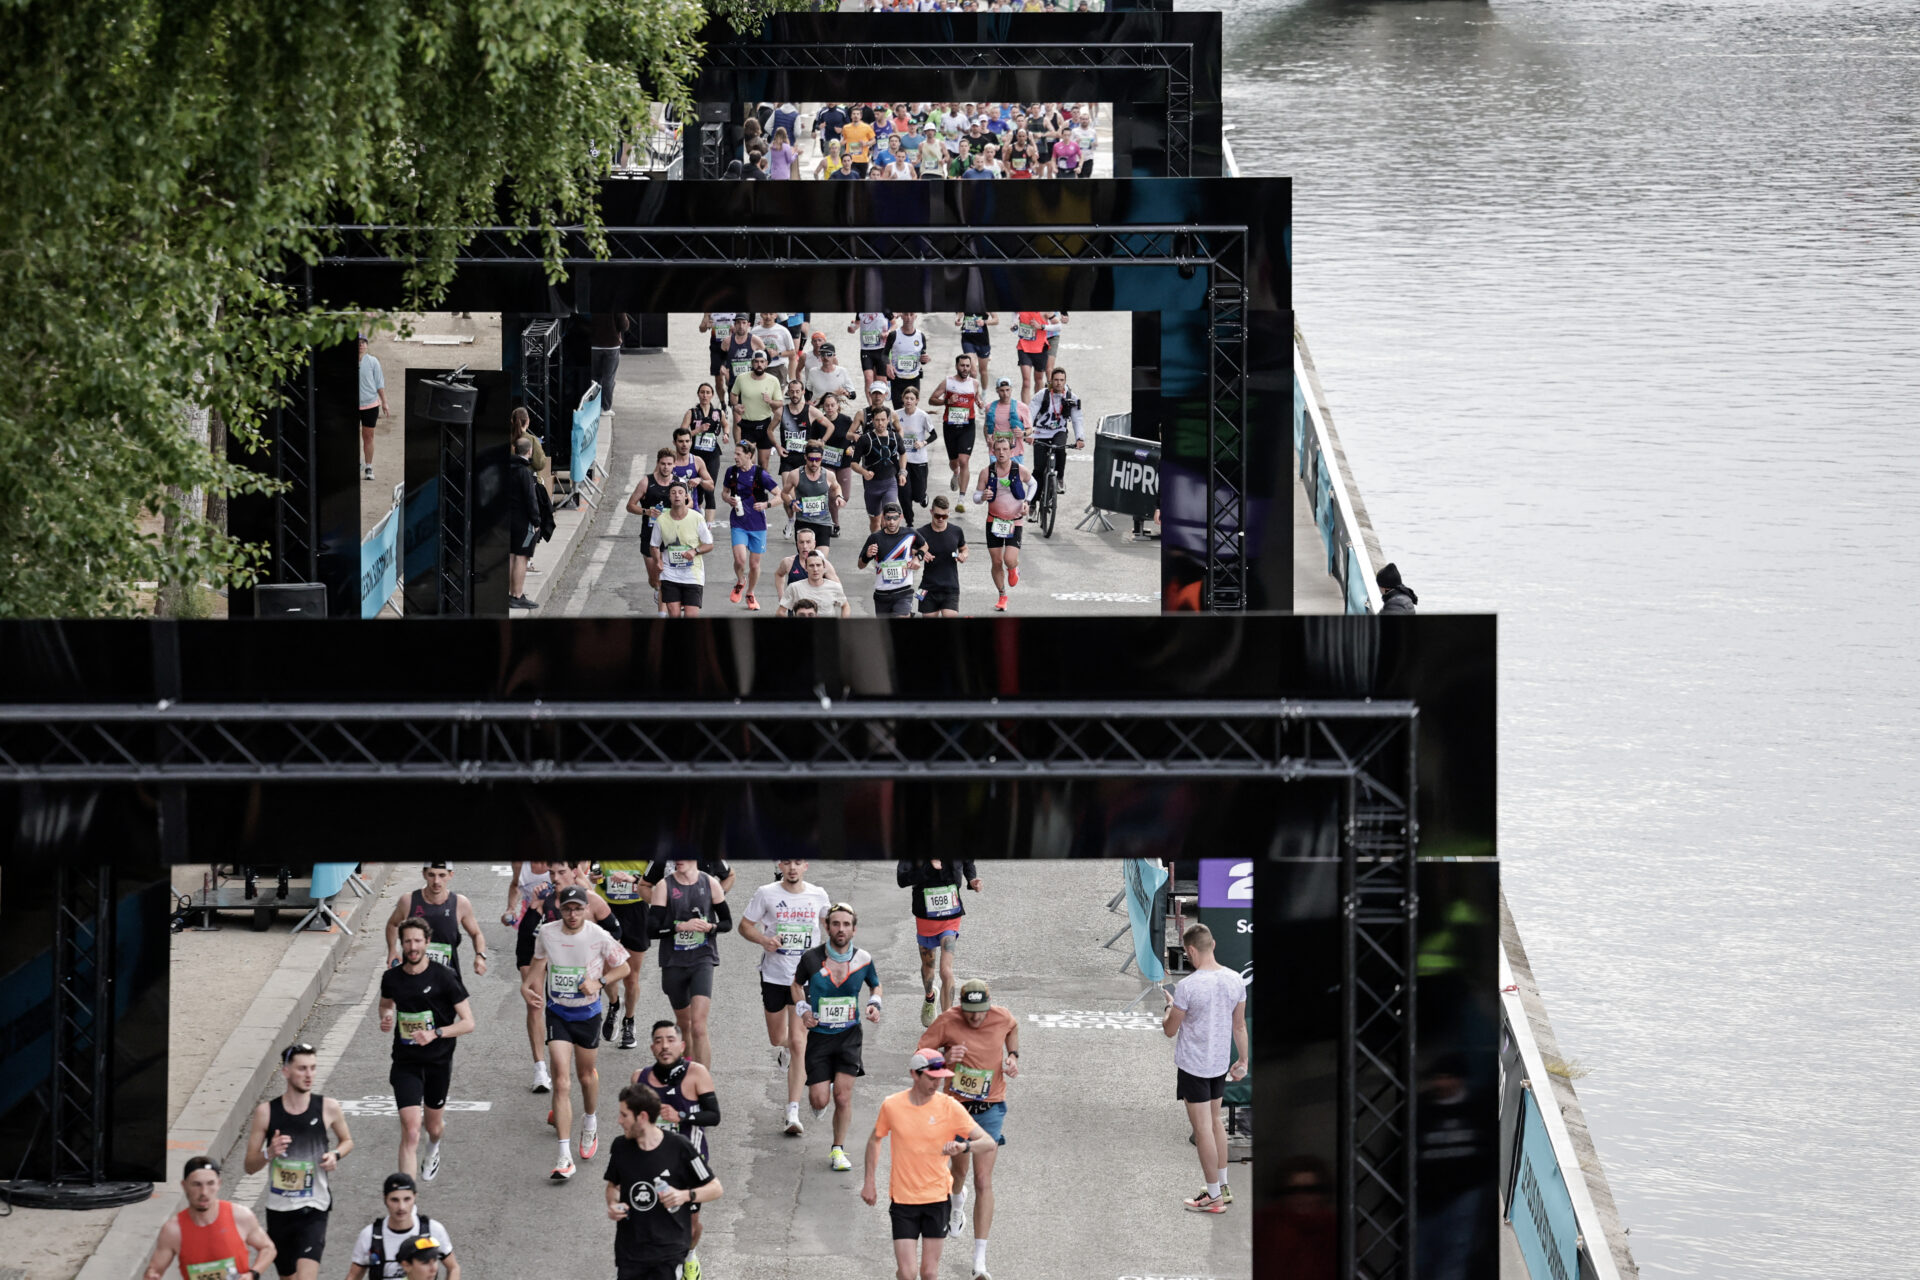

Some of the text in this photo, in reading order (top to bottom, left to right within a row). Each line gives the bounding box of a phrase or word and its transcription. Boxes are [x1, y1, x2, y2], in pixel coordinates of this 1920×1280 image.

[930, 895, 949, 906] 1698
[554, 975, 574, 987] 5205
[825, 1006, 844, 1017] 1487
[960, 1076, 977, 1089] 606
[280, 1170, 298, 1184] 970
